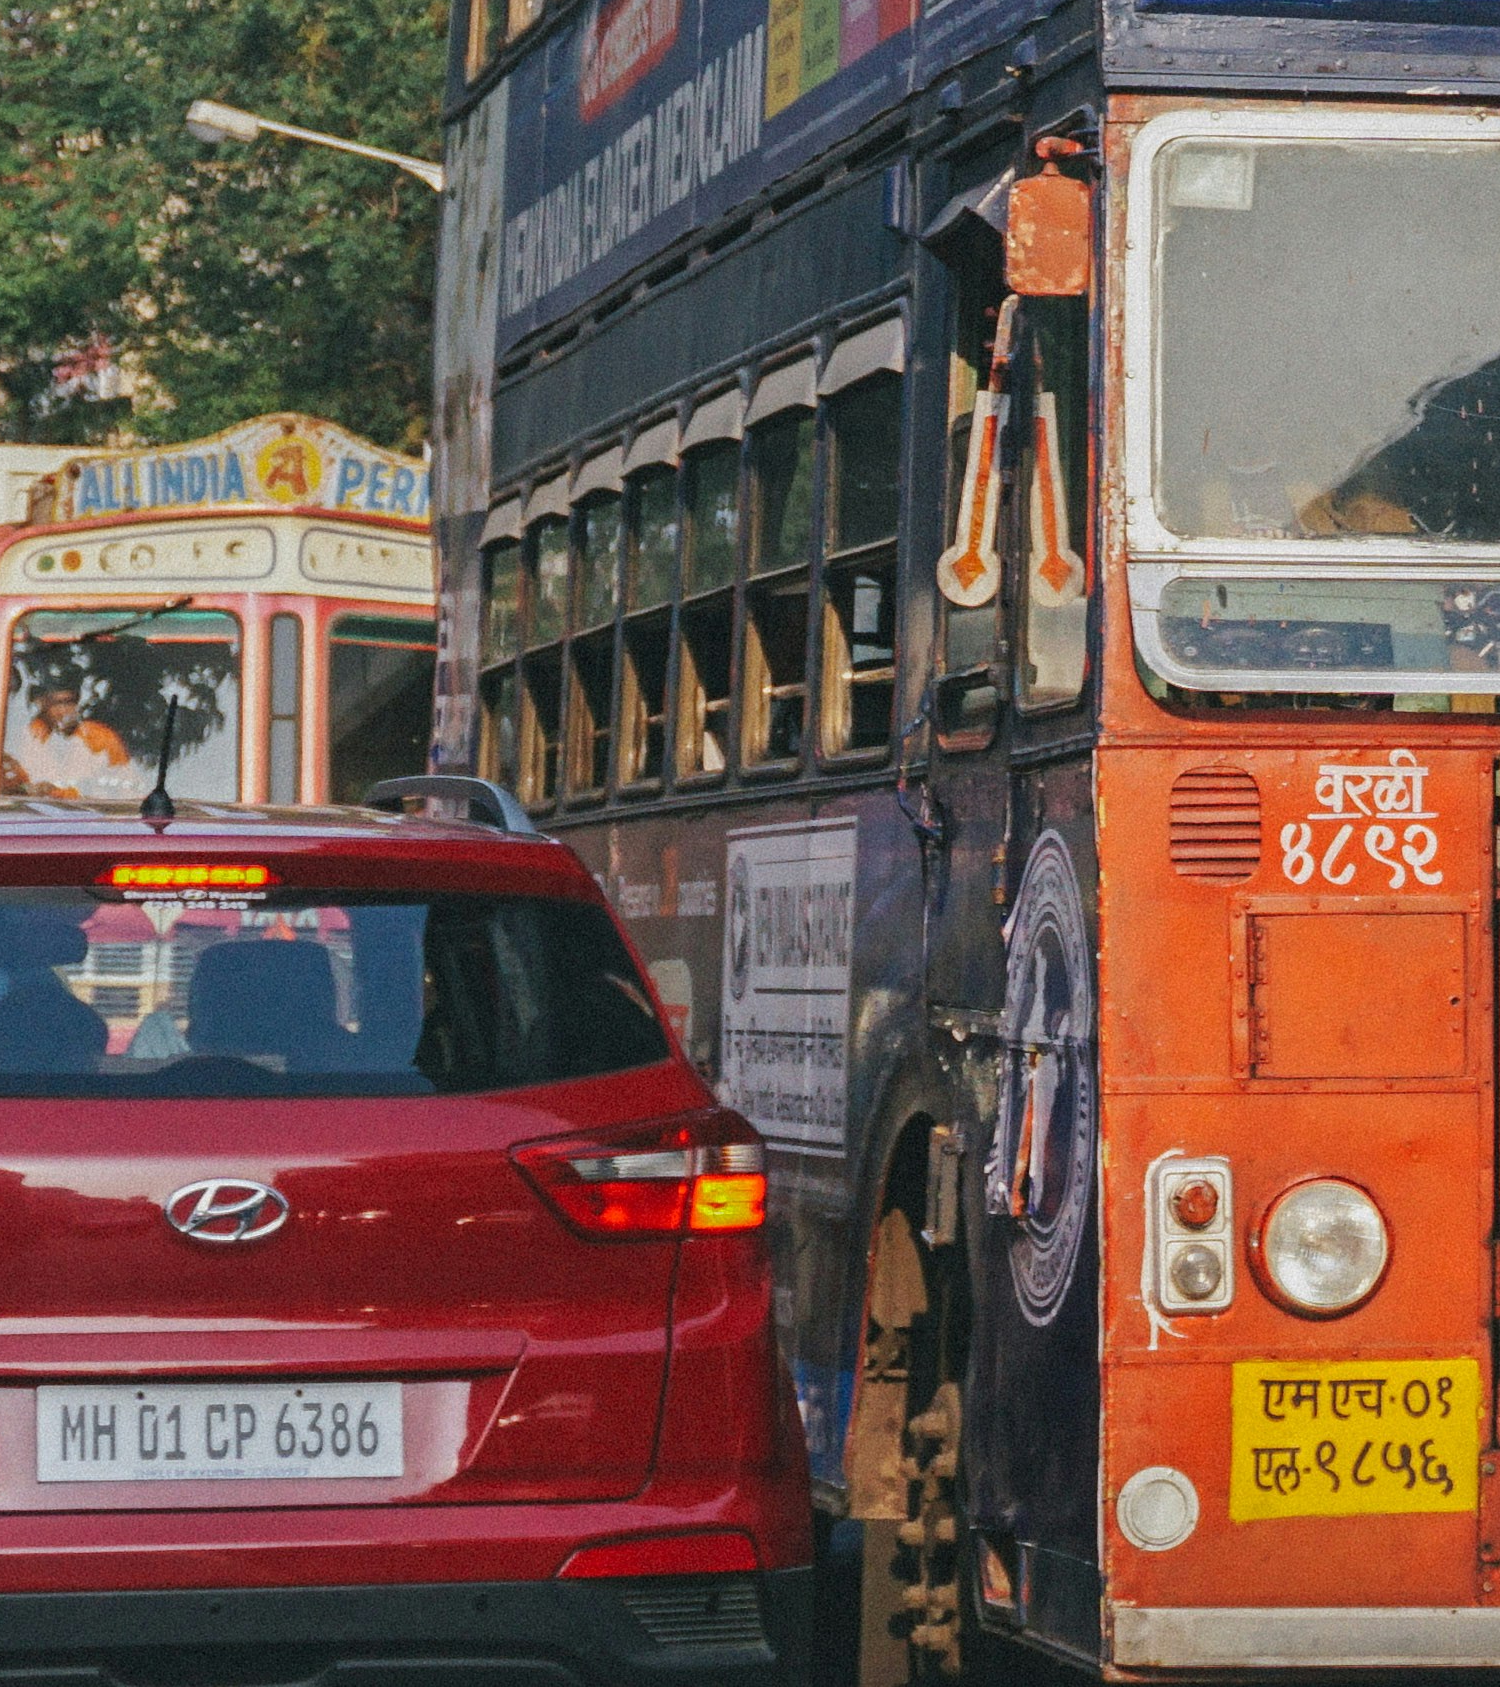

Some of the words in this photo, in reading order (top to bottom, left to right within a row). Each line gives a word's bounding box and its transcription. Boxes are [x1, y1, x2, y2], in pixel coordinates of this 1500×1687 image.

[79, 458, 136, 512] ALL
[148, 451, 247, 503] INDIA
[1314, 749, 1430, 816] वरळी
[1279, 822, 1444, 890] ४८९२
[60, 1404, 118, 1462] MH
[138, 1404, 187, 1461] 01
[205, 1404, 257, 1461] CP
[274, 1401, 380, 1459] 6386
